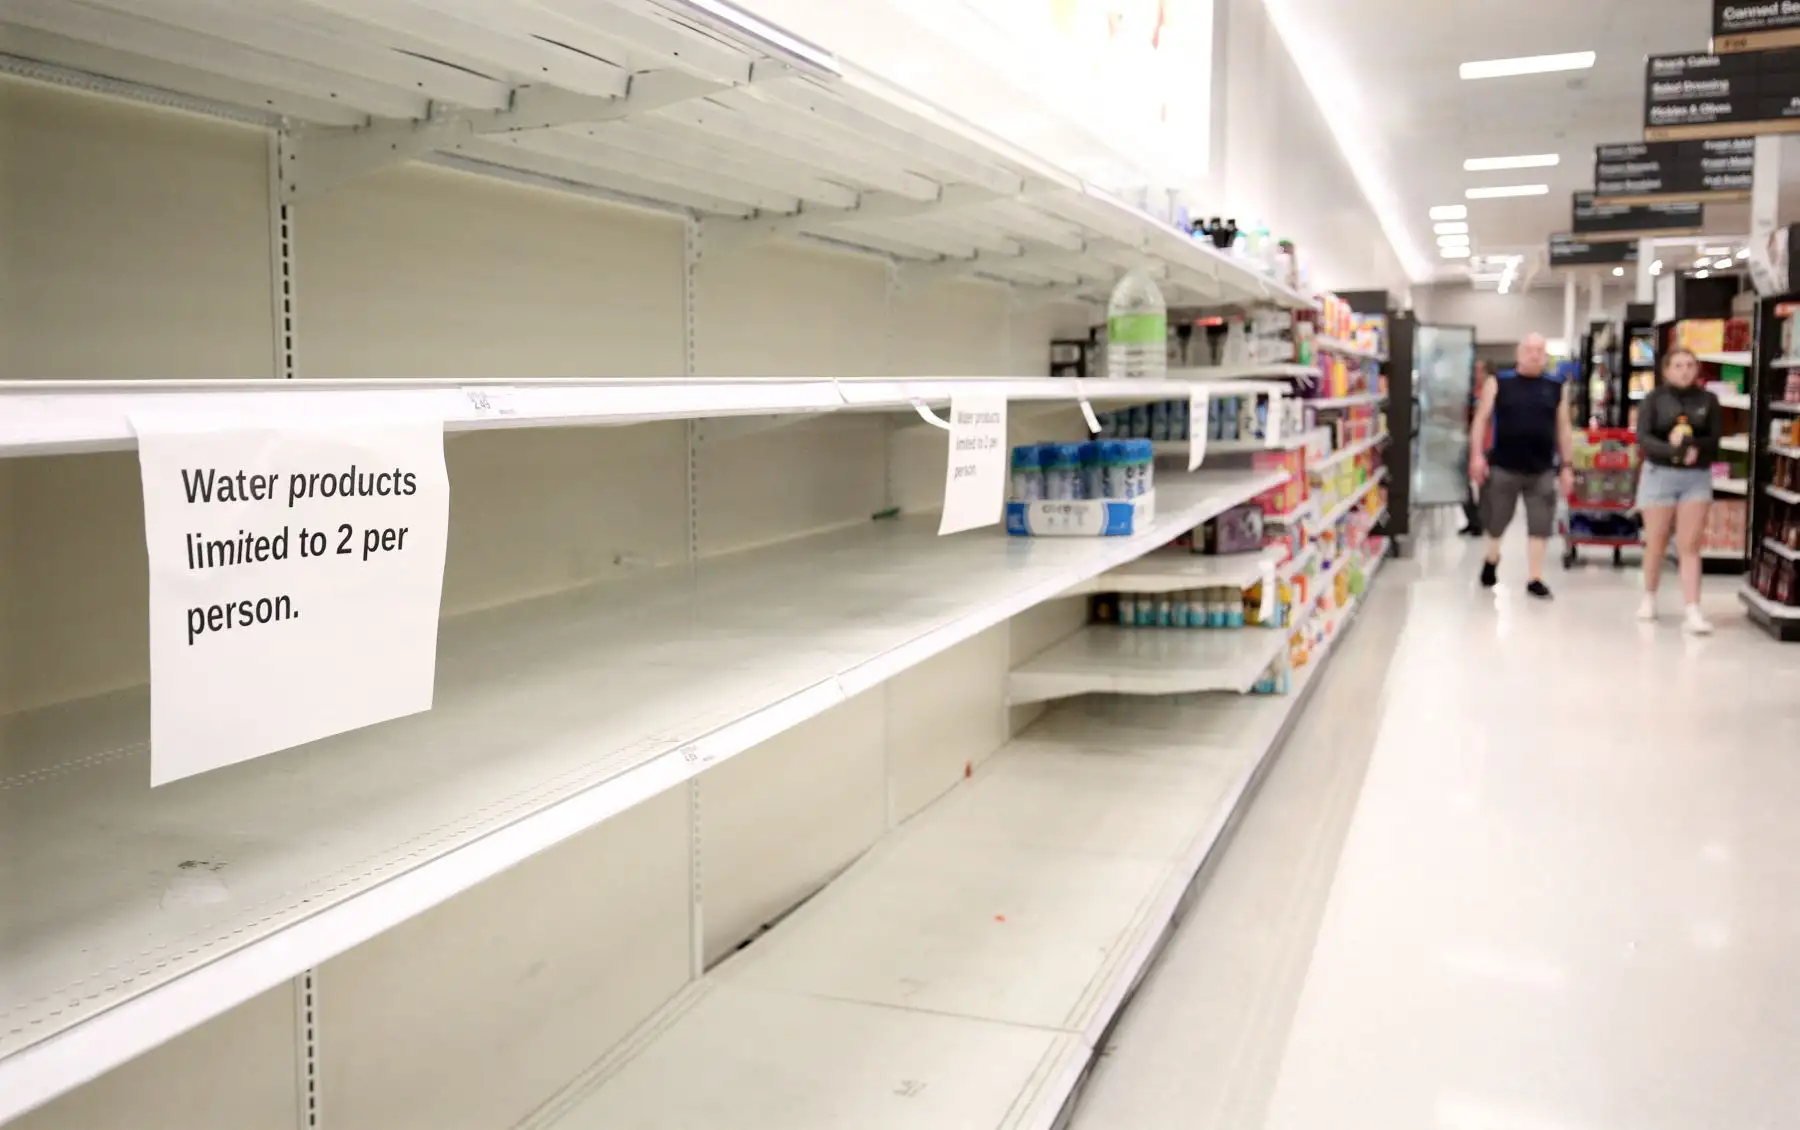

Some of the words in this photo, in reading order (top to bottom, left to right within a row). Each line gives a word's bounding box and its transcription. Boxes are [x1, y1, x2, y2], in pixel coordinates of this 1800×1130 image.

[181, 468, 279, 504] Water
[288, 464, 417, 508] products
[186, 525, 289, 570] limited
[298, 527, 327, 558] to
[336, 523, 353, 555] 2
[362, 527, 409, 562] per
[187, 593, 299, 646] person.
